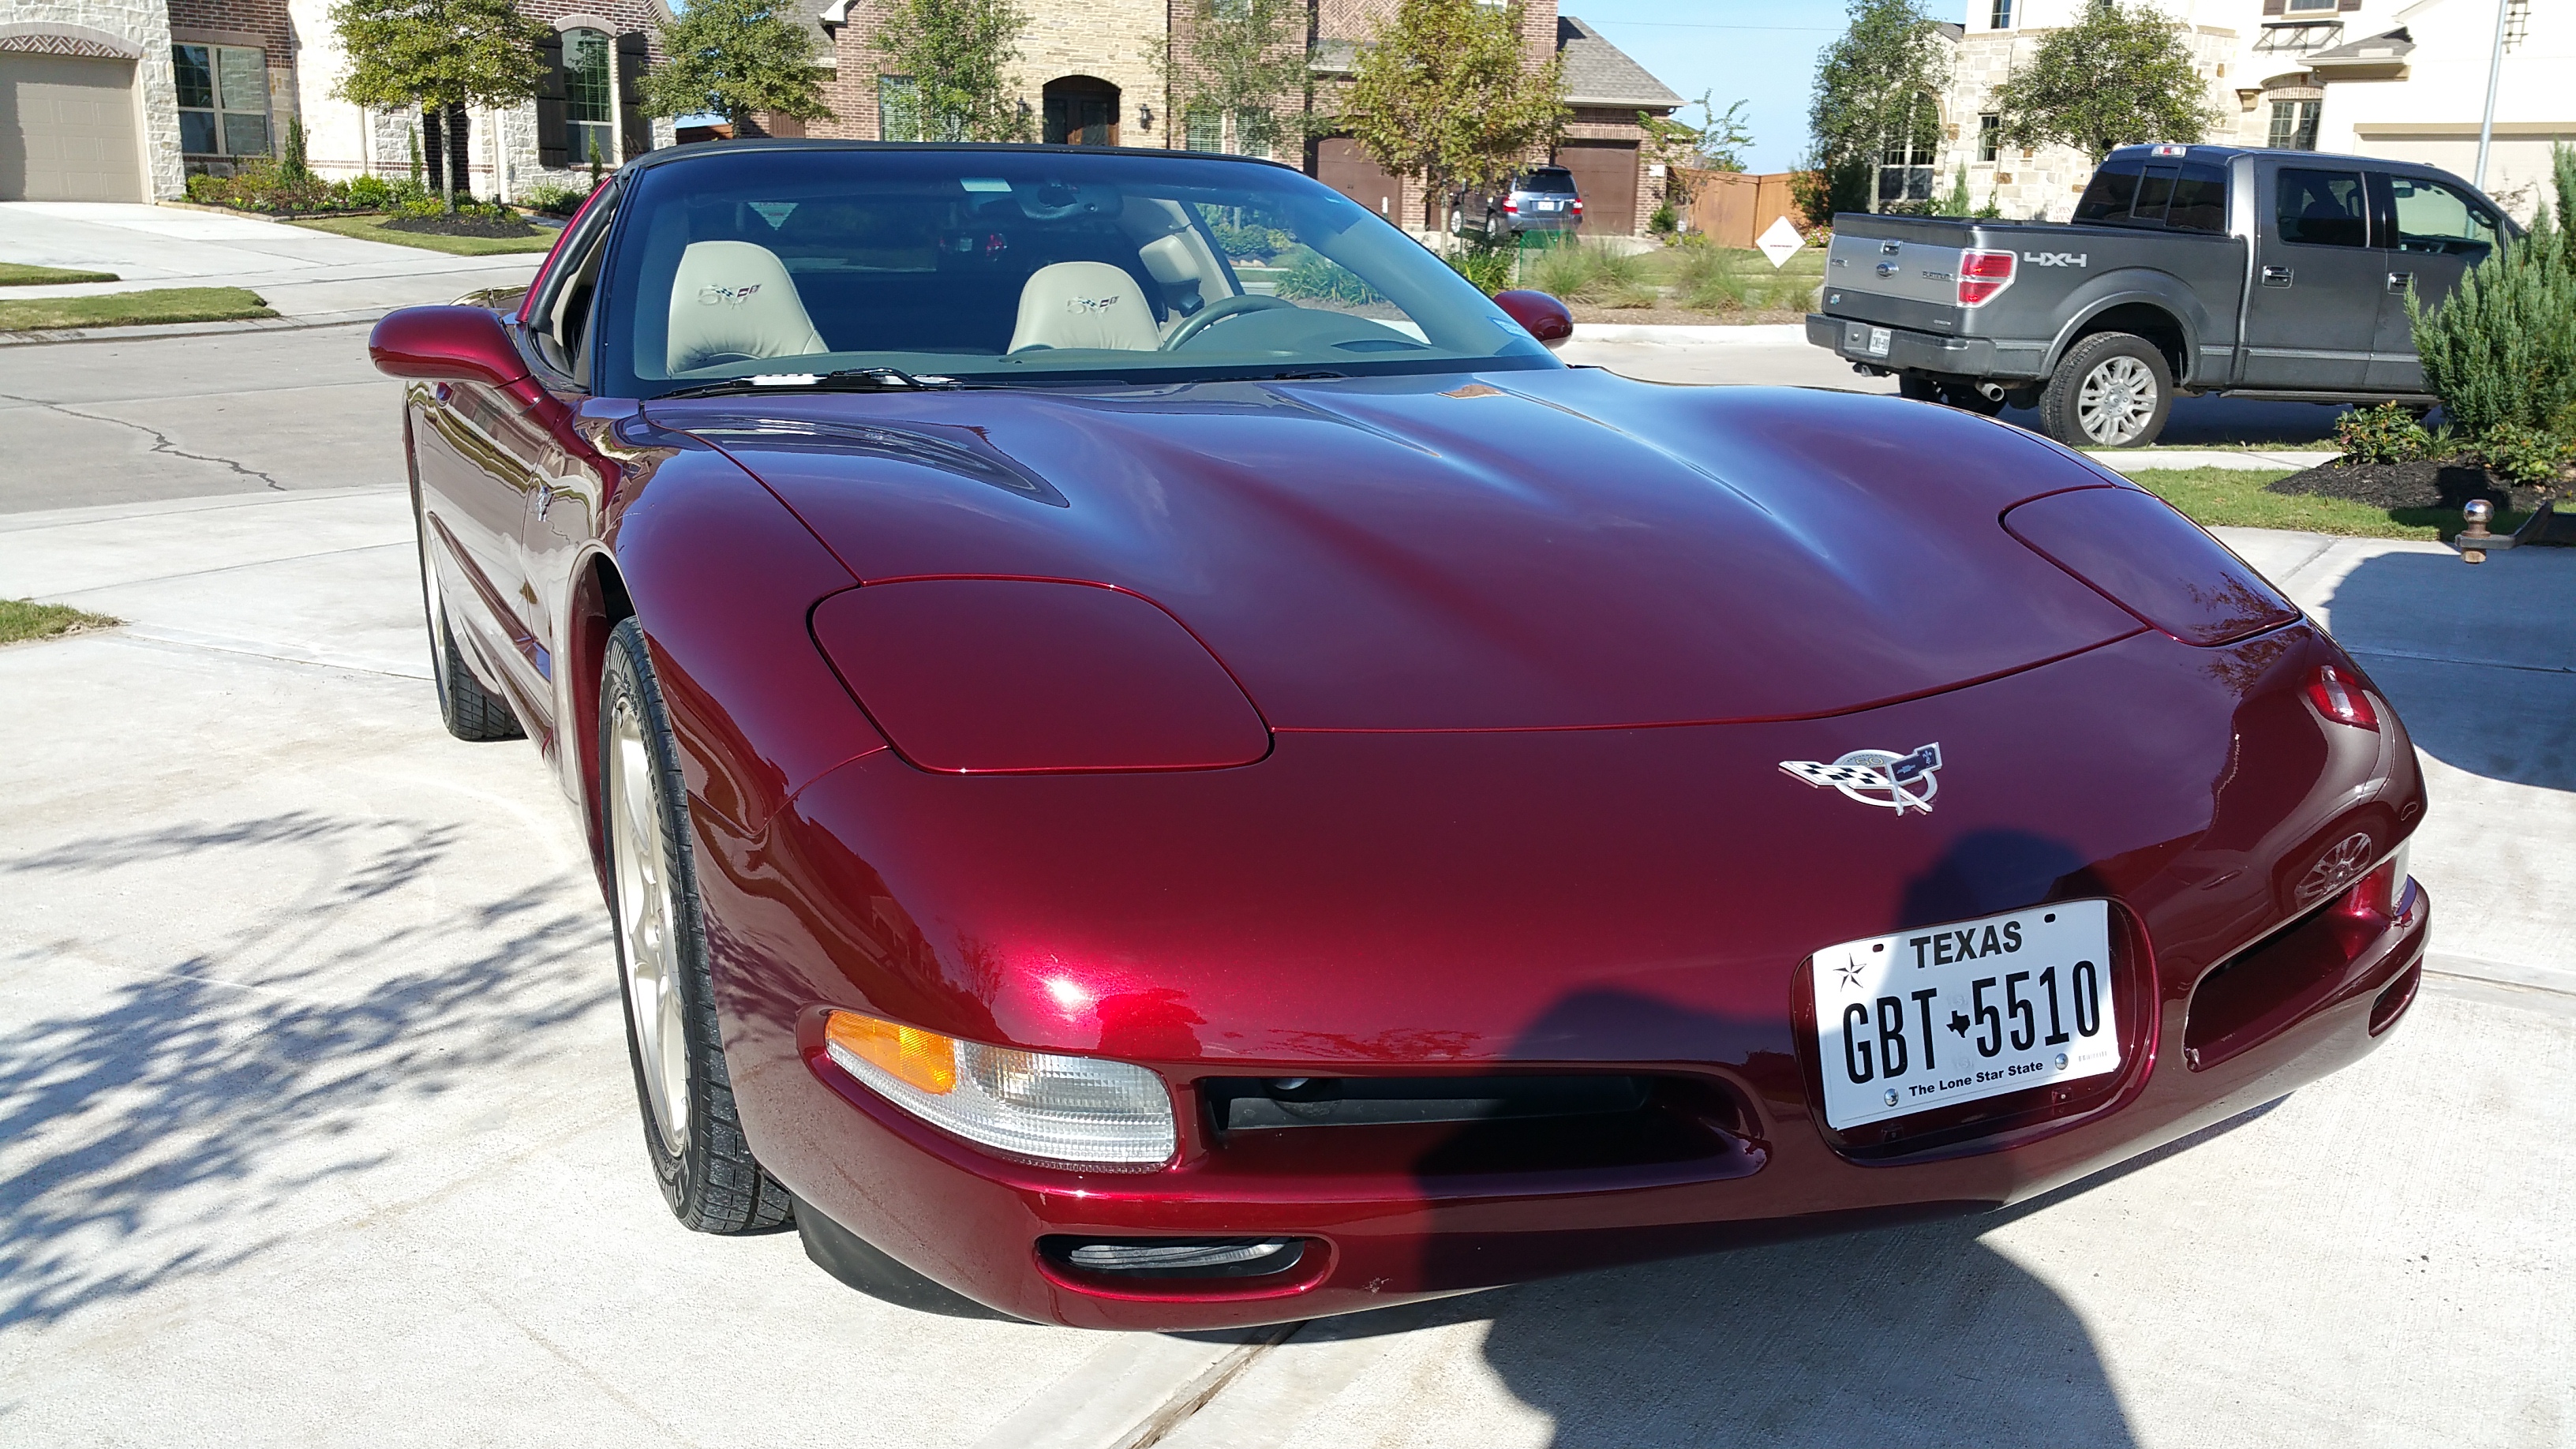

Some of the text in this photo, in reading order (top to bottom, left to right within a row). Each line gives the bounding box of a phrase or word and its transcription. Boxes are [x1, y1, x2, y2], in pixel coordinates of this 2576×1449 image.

[1855, 757, 1885, 766] 50
[1910, 920, 2022, 969] TEXAS
[1843, 960, 2100, 1085] GBT 5510
[1908, 1061, 2043, 1097] The Lone Star State
